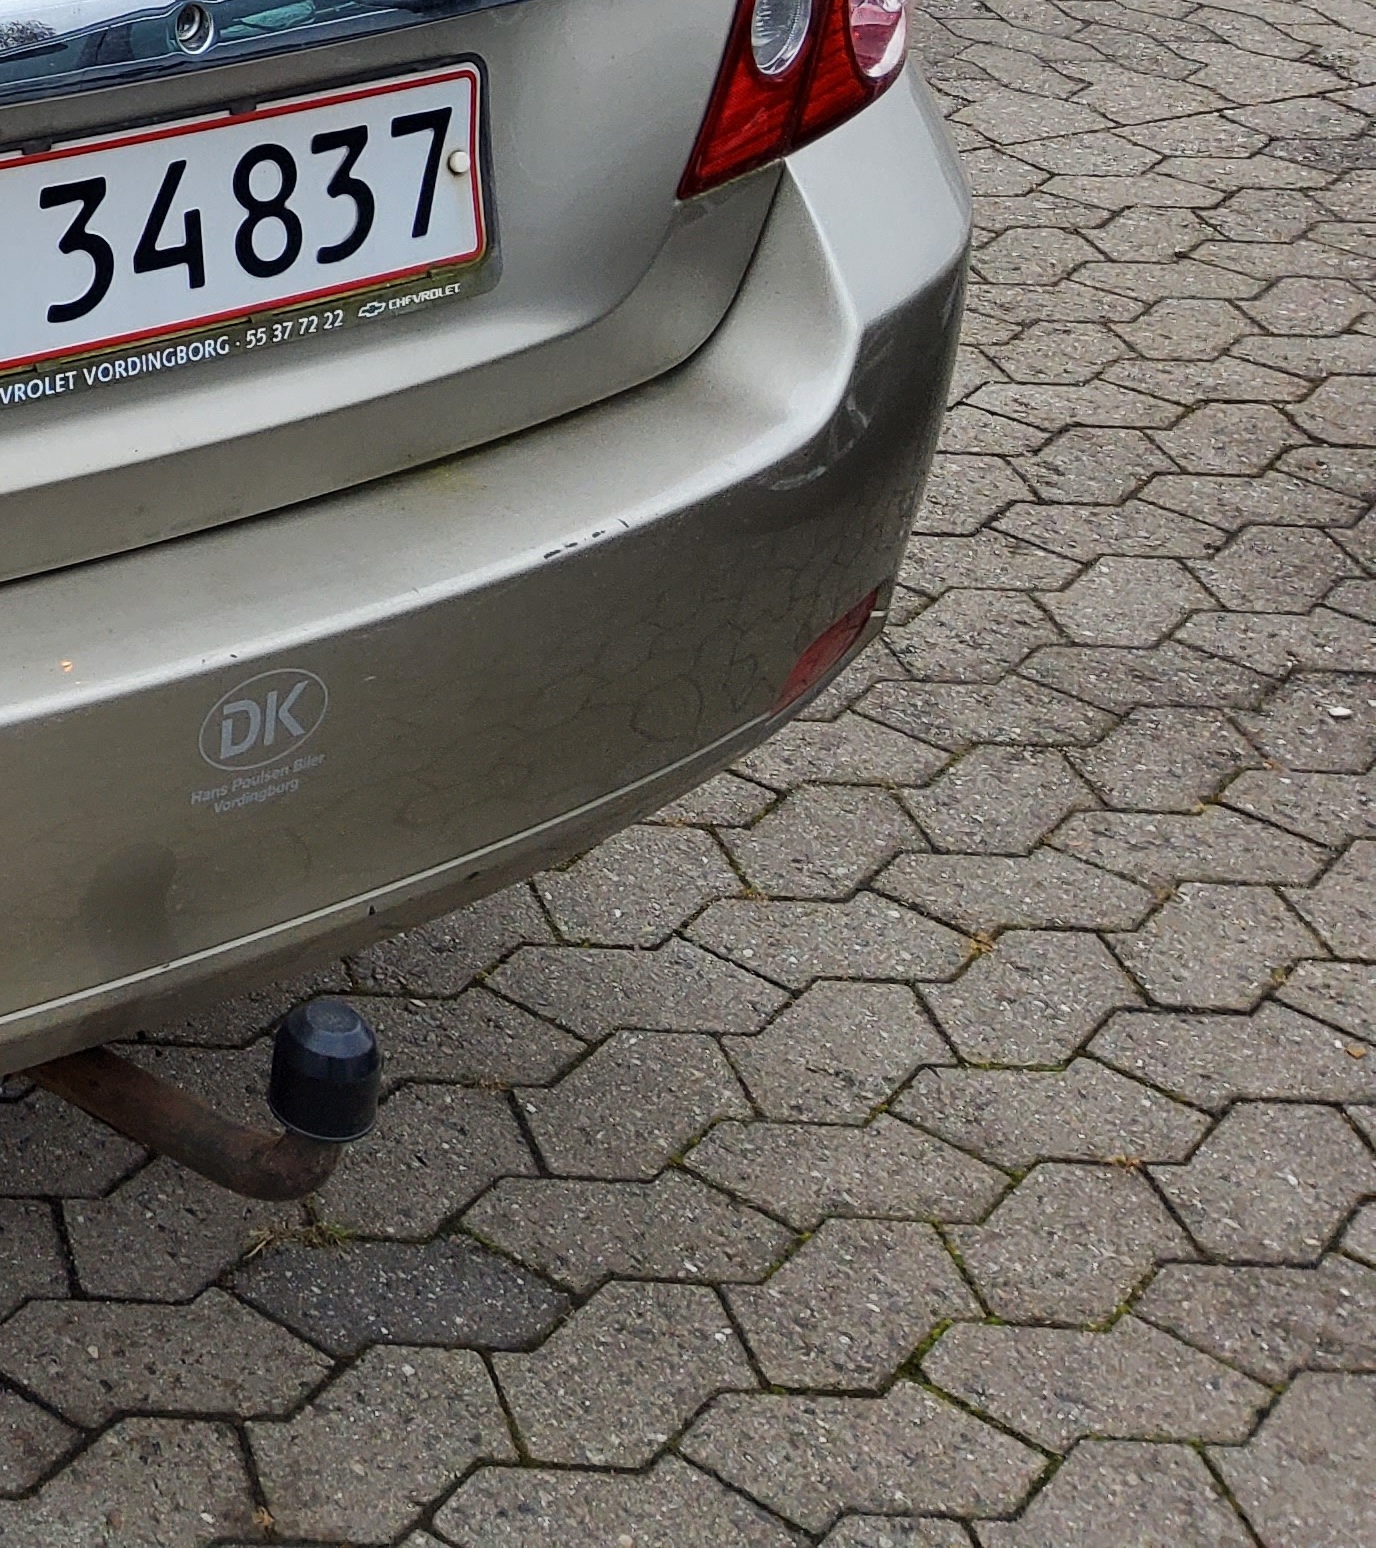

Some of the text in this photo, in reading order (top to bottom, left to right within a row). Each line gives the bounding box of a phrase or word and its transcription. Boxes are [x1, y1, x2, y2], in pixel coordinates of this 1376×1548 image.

[83, 335, 231, 385] VORDINGBORG
[245, 327, 267, 349] 55
[272, 321, 294, 343] 37
[298, 315, 318, 336] 72
[323, 310, 344, 330] 22
[220, 680, 309, 759] DK
